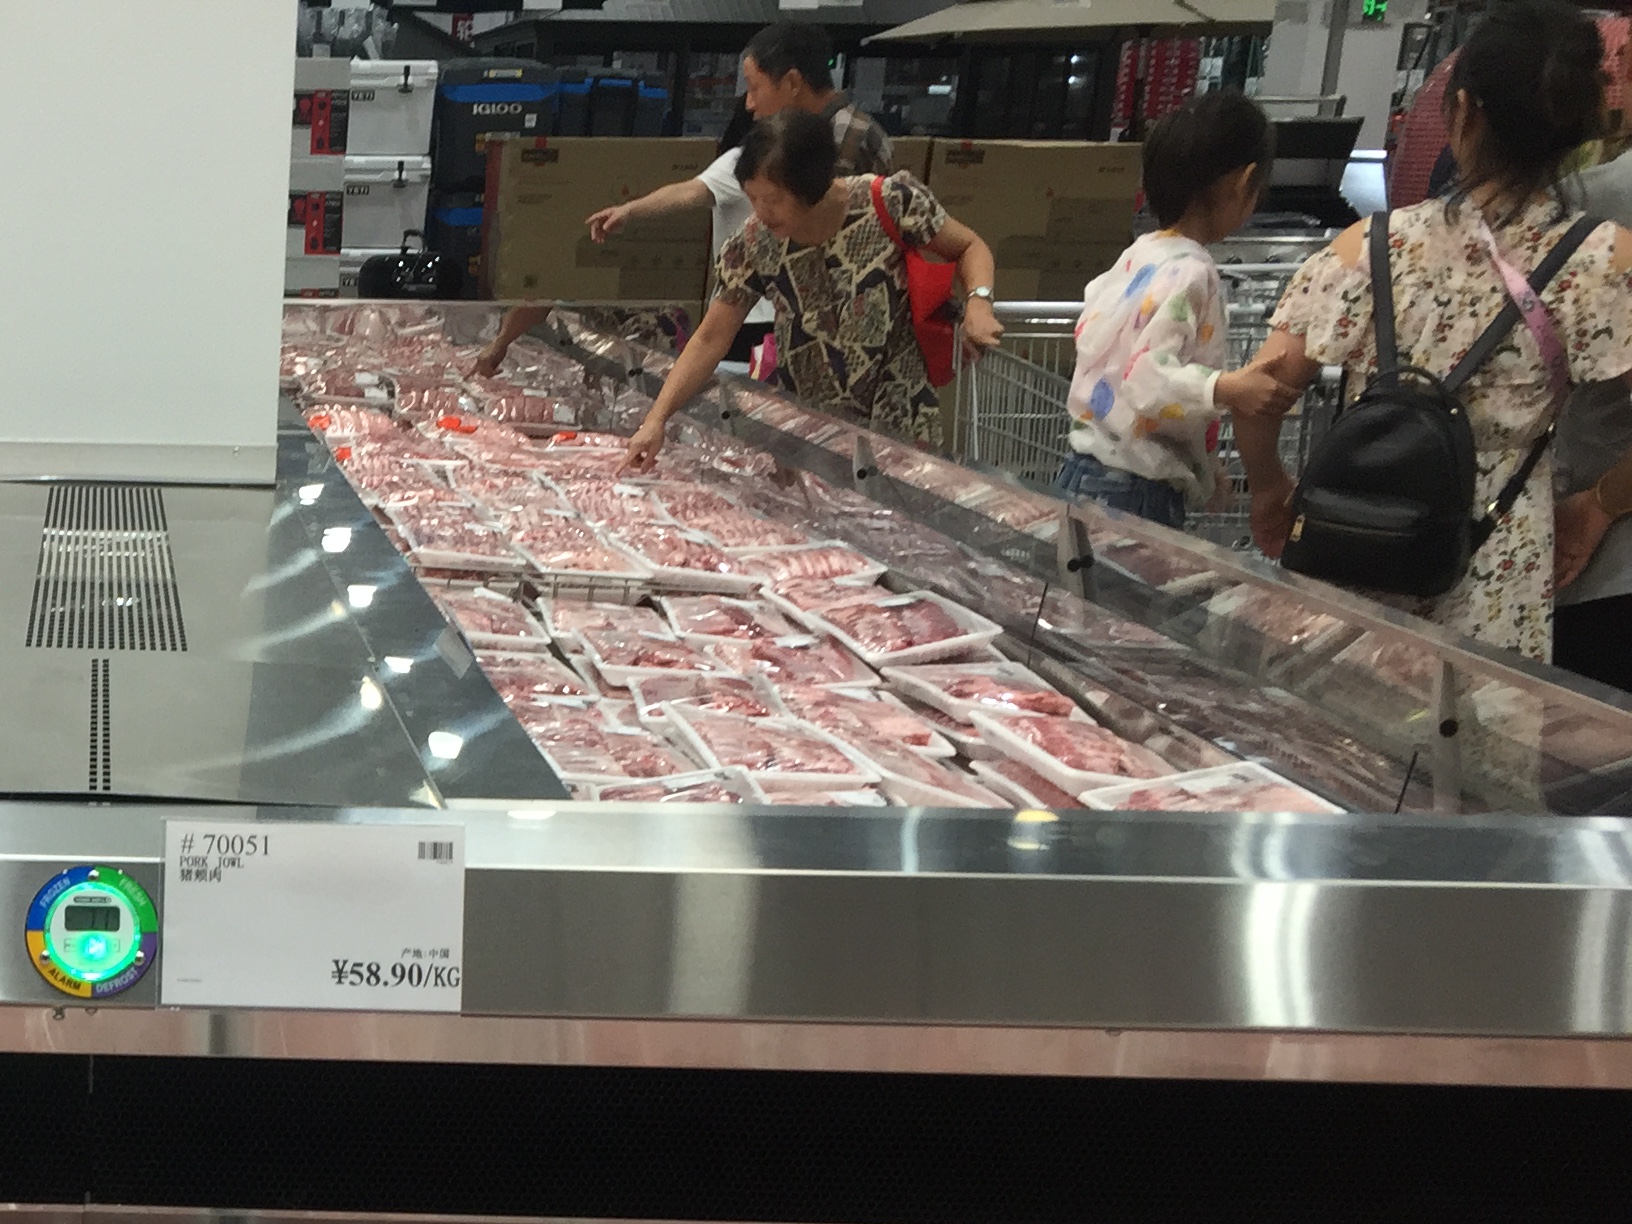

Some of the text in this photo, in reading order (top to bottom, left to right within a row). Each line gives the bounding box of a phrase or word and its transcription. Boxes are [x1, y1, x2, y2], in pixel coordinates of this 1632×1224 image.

[472, 103, 522, 115] IGLOO
[181, 834, 269, 856] # 70051
[180, 856, 244, 869] PORK JOWL
[39, 876, 71, 909] FROZEN
[119, 878, 147, 906] FRESH
[48, 968, 82, 990] ALARM
[95, 967, 138, 993] DEFROST
